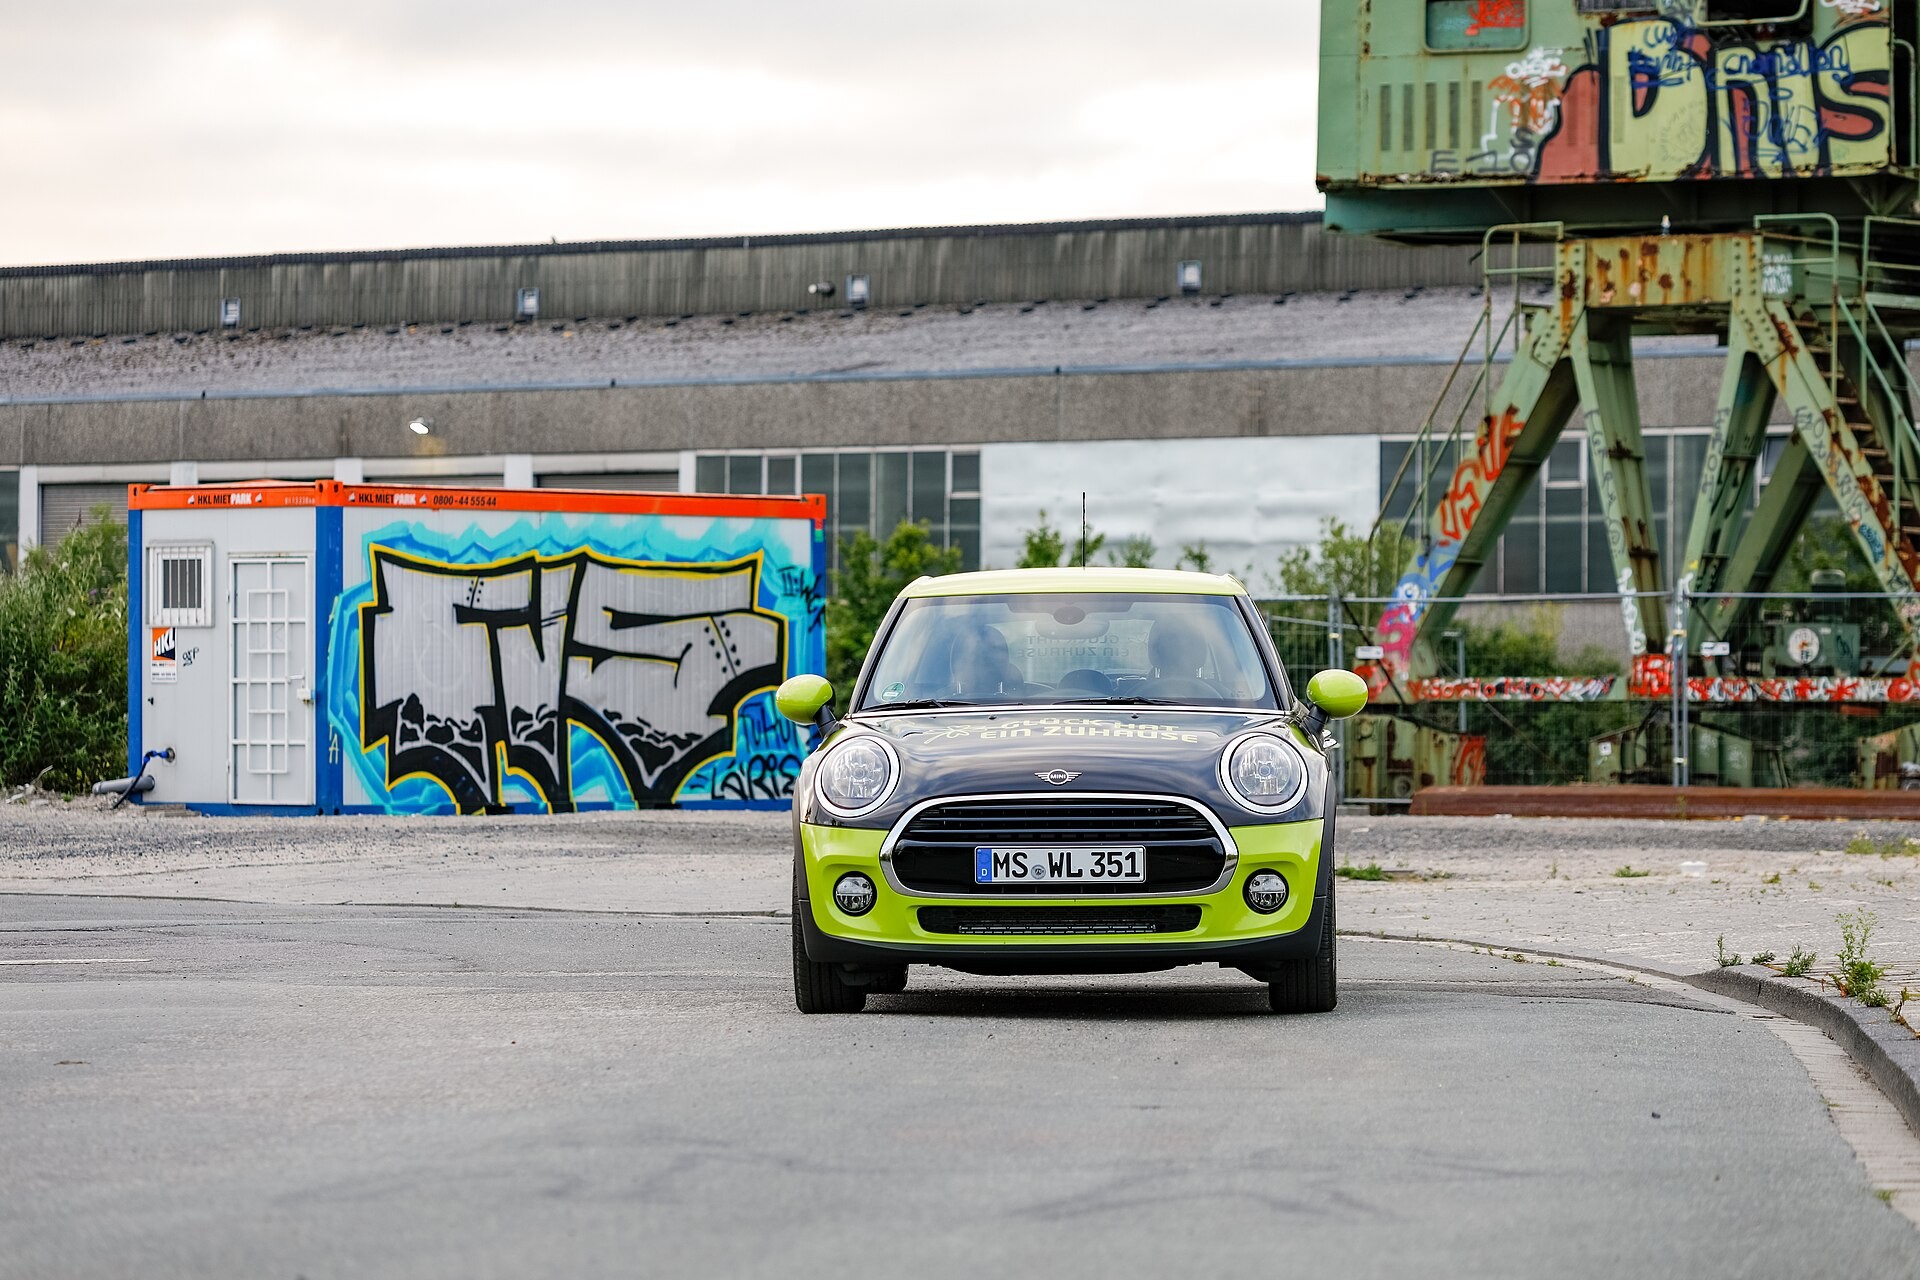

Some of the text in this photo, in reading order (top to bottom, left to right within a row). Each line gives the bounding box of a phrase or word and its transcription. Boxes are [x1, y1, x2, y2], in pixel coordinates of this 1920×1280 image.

[197, 493, 252, 505] HKL MIETPARK
[358, 493, 417, 505] HKL MIETPARK
[153, 628, 175, 657] HKL
[1114, 721, 1180, 732] HAT
[980, 725, 1198, 744] EIN ZUHAUSE
[981, 851, 1141, 878] D MS WL 351
